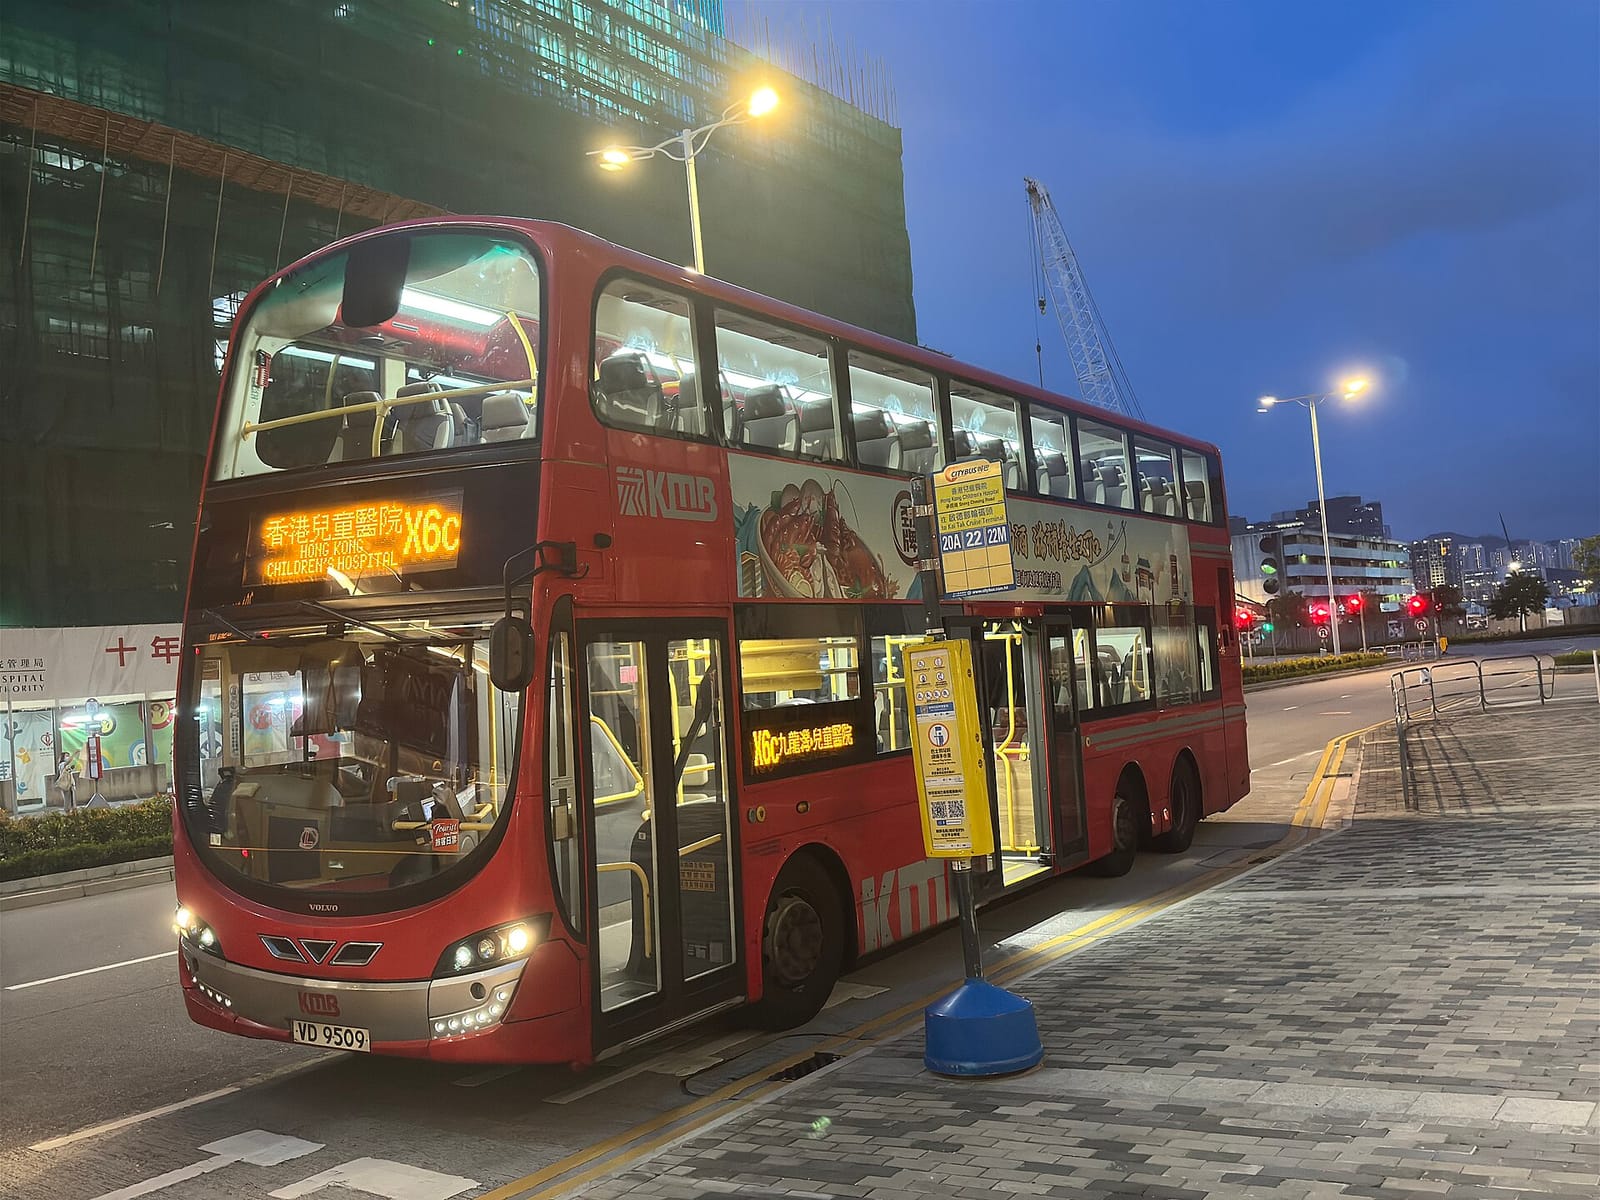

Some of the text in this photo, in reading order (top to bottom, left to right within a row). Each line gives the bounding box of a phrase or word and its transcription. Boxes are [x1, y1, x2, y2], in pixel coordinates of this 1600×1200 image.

[951, 466, 977, 477] CITYBUS
[646, 470, 718, 522] KMB
[266, 505, 403, 547] 香港兒童醫院
[957, 521, 965, 529] Tak
[982, 514, 1004, 524] Terminal
[299, 538, 365, 559] HONG KONG
[942, 526, 1007, 551] 20A 22 22M
[266, 552, 399, 578] CHILDREN'S HOSPITAL
[308, 903, 339, 912] VOLVO
[861, 858, 960, 954] KM
[297, 991, 341, 1018] KMB
[297, 1022, 365, 1049] VD 9509
